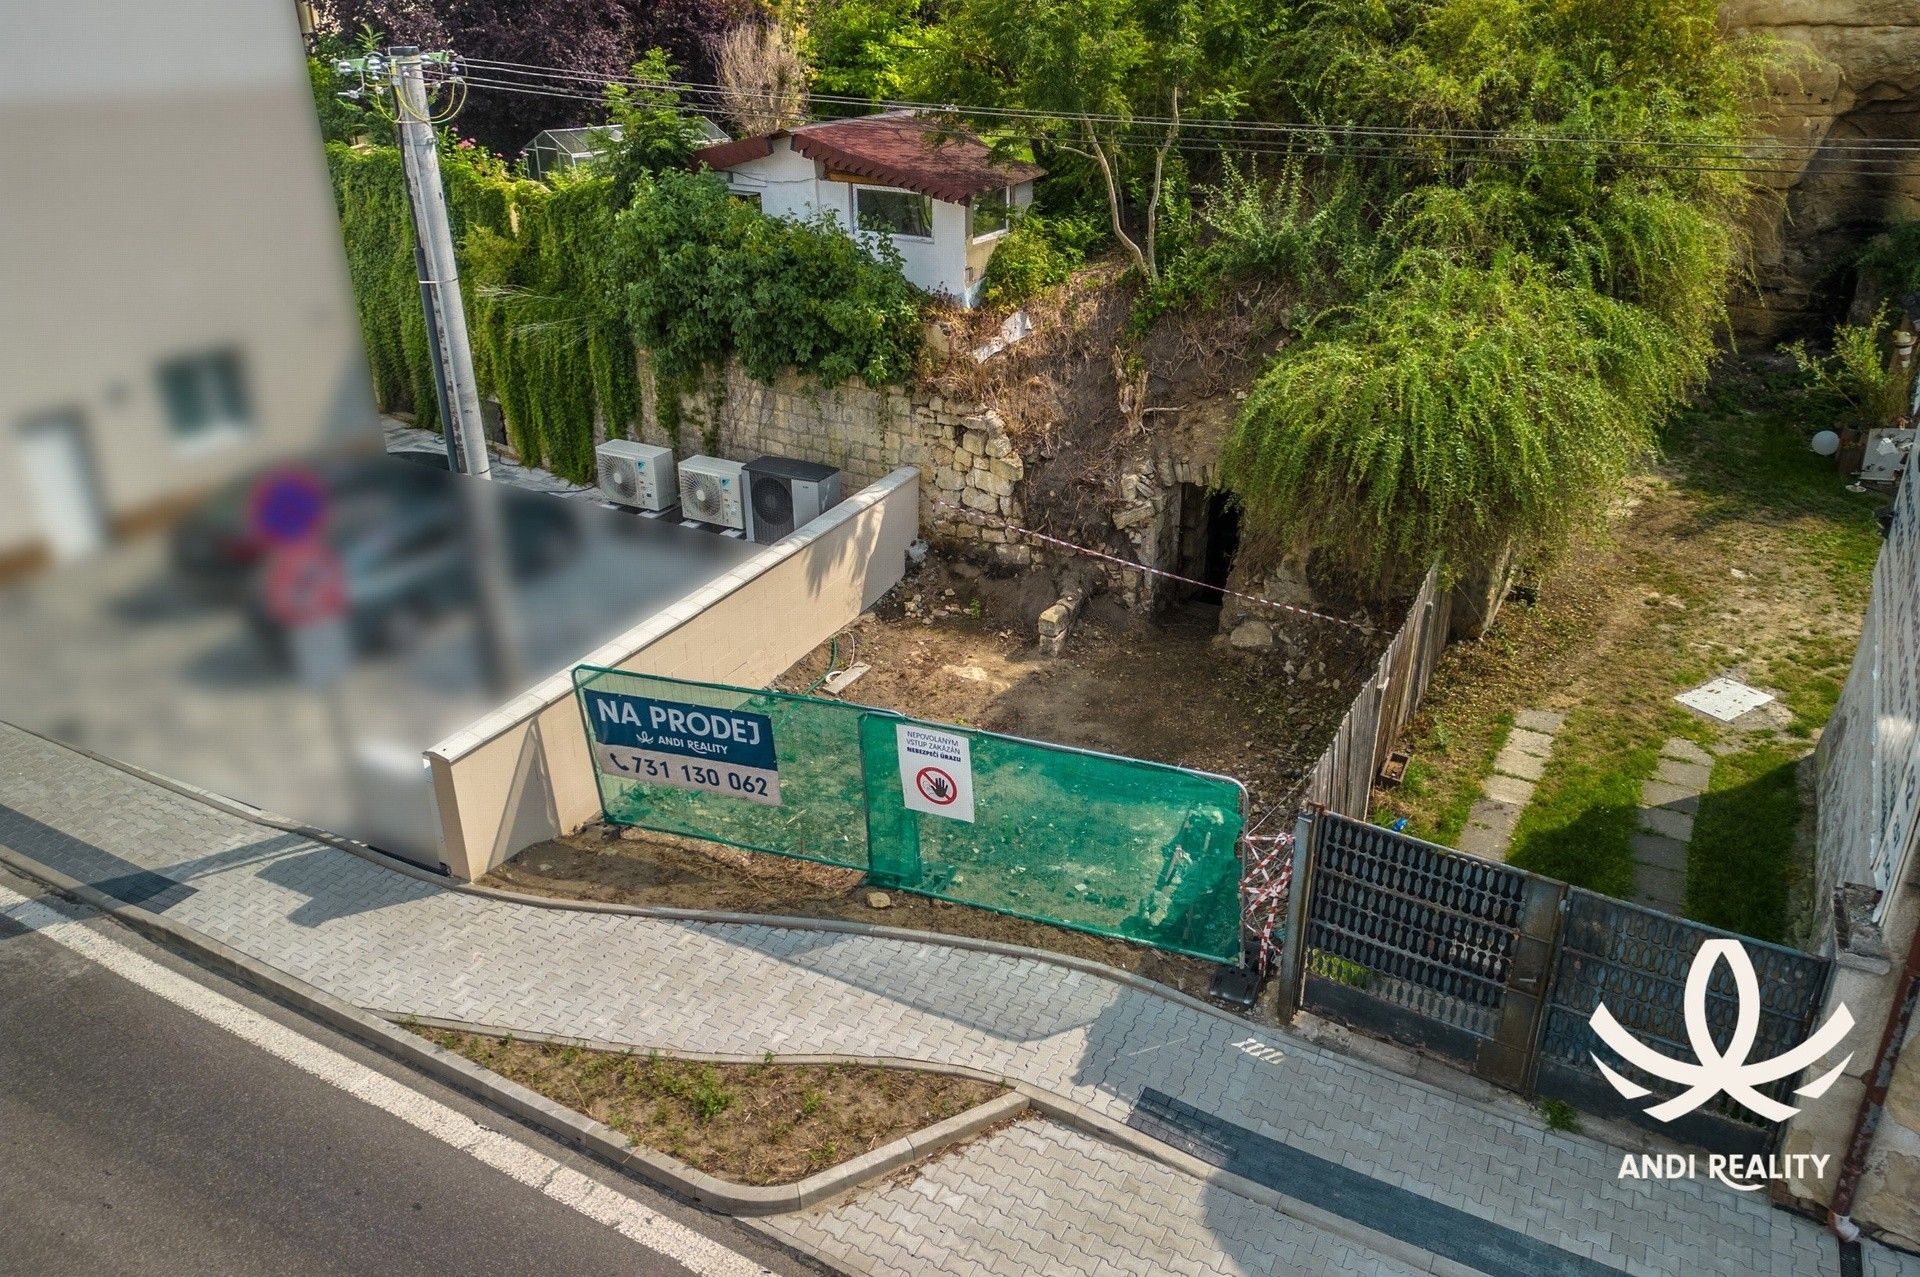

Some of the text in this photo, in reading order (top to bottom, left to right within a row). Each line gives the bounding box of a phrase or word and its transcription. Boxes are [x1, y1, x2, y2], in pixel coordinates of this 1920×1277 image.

[597, 698, 760, 746] NA PRODEJ
[658, 735, 728, 755] ANDI REALITY
[906, 738, 927, 748] VSTUP
[940, 752, 961, 762] ÚRAZU
[631, 756, 769, 797] 731 130 062
